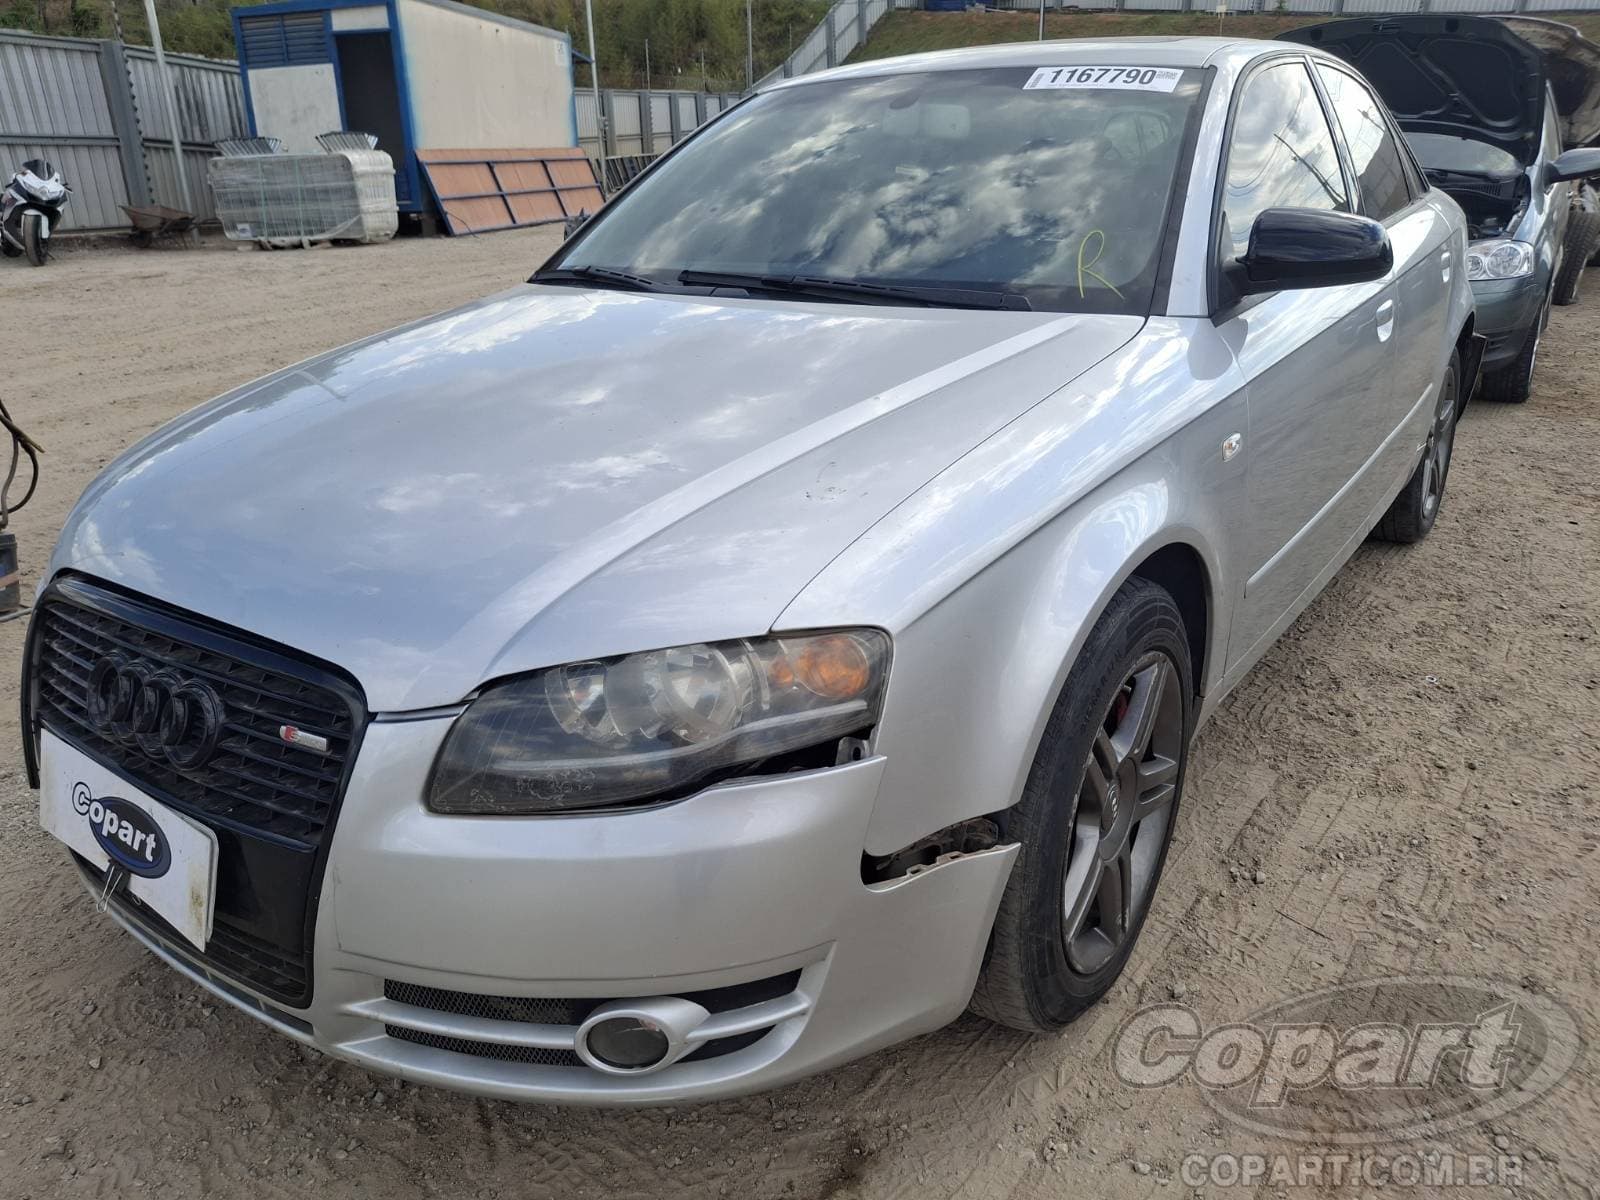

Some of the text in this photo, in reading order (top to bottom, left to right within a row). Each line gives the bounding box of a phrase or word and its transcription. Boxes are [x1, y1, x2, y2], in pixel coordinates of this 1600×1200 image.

[1050, 68, 1157, 85] 1167790
[1077, 229, 1126, 300] R
[72, 781, 157, 862] Copart
